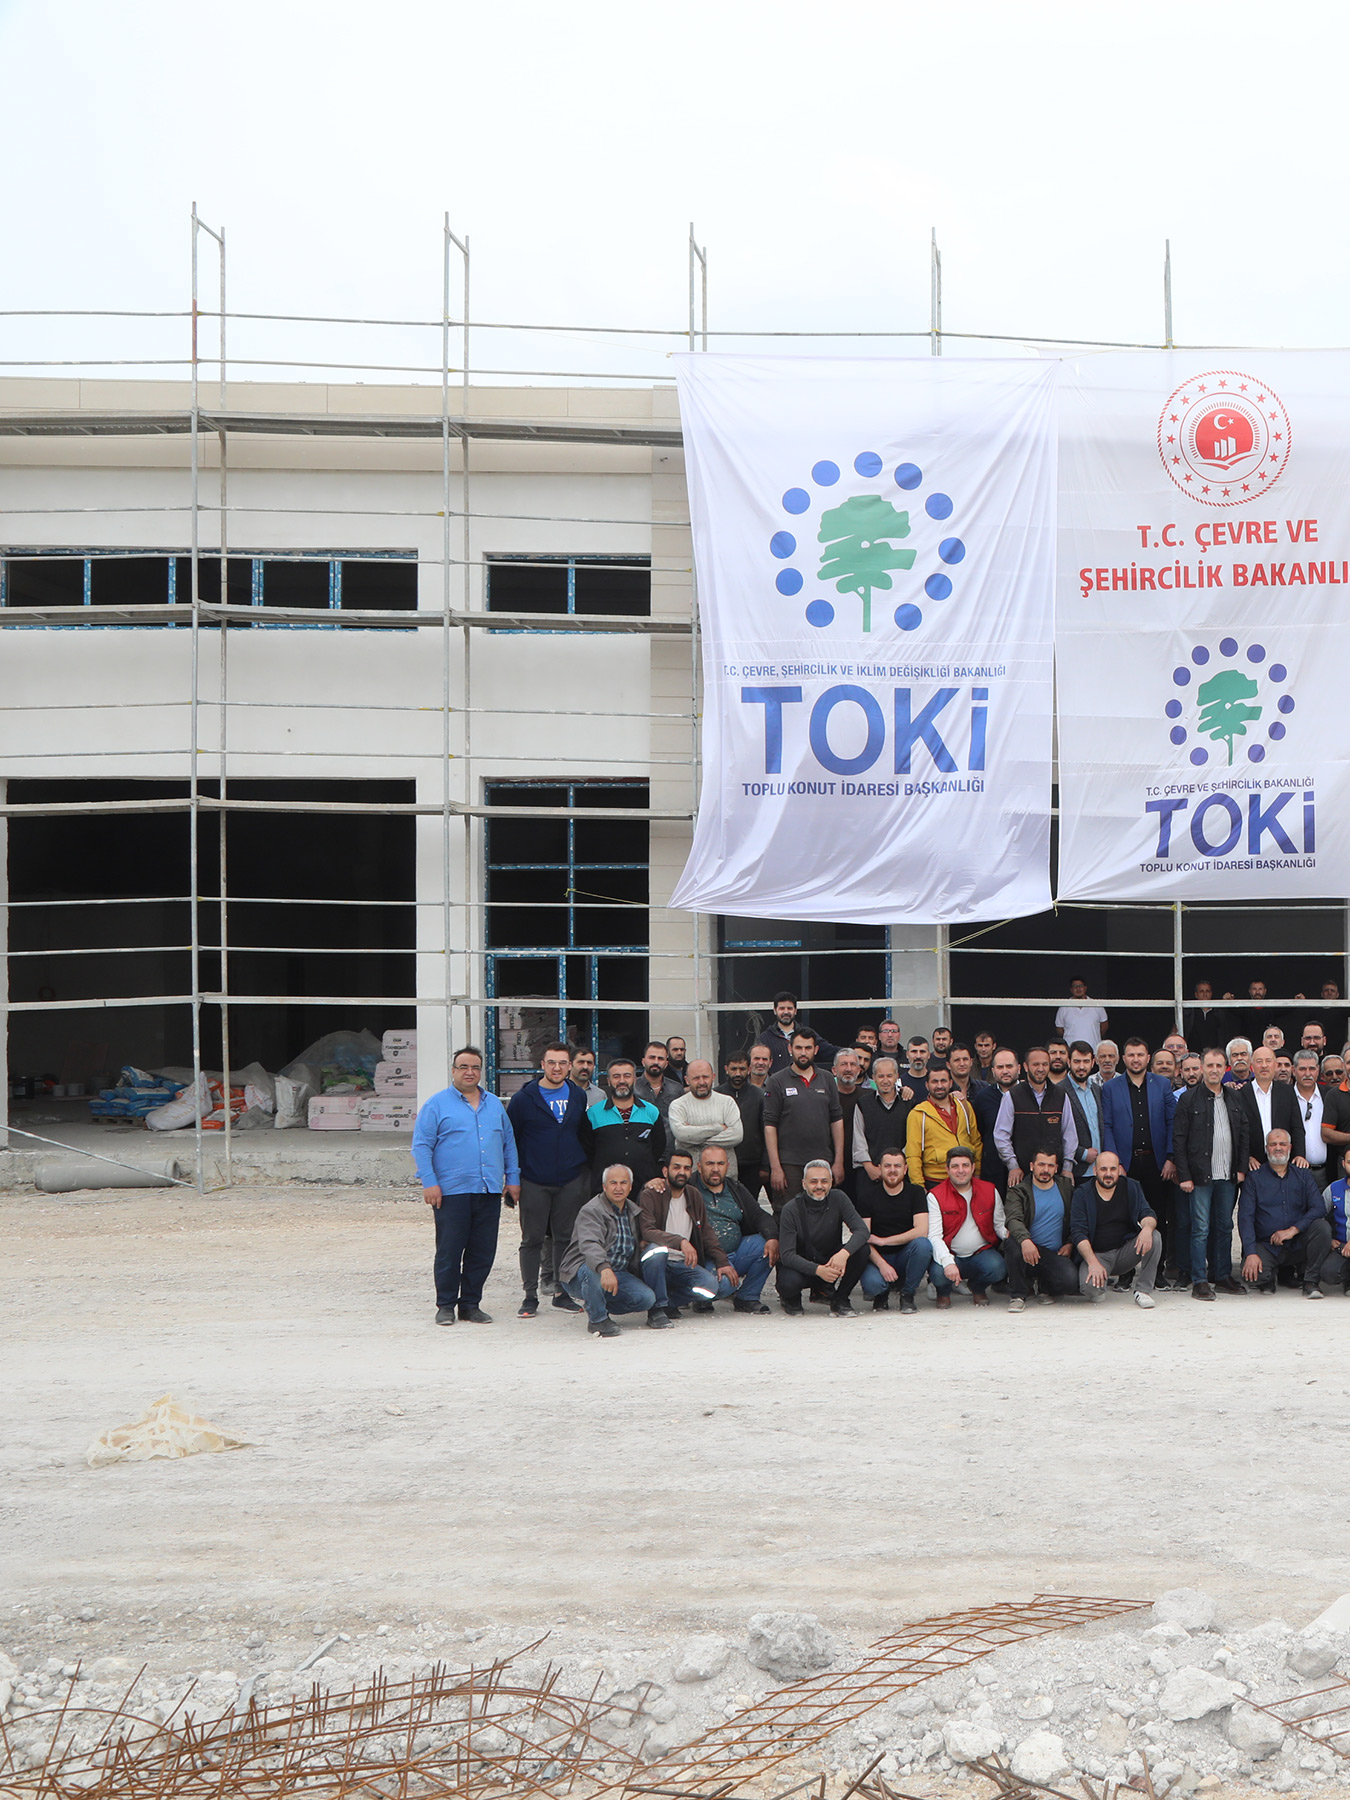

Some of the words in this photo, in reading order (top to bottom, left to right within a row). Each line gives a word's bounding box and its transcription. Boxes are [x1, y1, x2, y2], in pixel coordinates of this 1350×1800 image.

[1137, 523, 1185, 548] T.C.
[1194, 520, 1278, 553] ÇEVRE
[1285, 519, 1319, 543] VE
[1079, 559, 1223, 598] ŞEHİRCİLİK
[742, 665, 779, 678] ÇEVRE,
[781, 662, 837, 678] ŞEHİRCİLİK
[840, 665, 854, 675] VE
[857, 663, 886, 676] İKLİM
[889, 664, 950, 680] DEĞİŞİKLİĞİ
[953, 664, 1006, 678] BAKANLIĞI
[742, 782, 785, 797] TOPLU
[787, 781, 836, 796] KONUT
[841, 779, 899, 797] İDARESİ
[904, 776, 984, 798] BAŞKANLIĞI
[1146, 787, 1162, 796] T.C.
[1164, 784, 1195, 796] ÇEVRE
[1197, 783, 1209, 792] VE
[1211, 778, 1262, 792] ŞEHİRCİLİK
[1264, 776, 1315, 788] BAKANLIĞI
[1140, 863, 1173, 873] TOPLU
[1175, 861, 1211, 872] KONUT
[1213, 858, 1254, 871] İDARESİ
[1256, 856, 1316, 871] BAŞKANLIĞI
